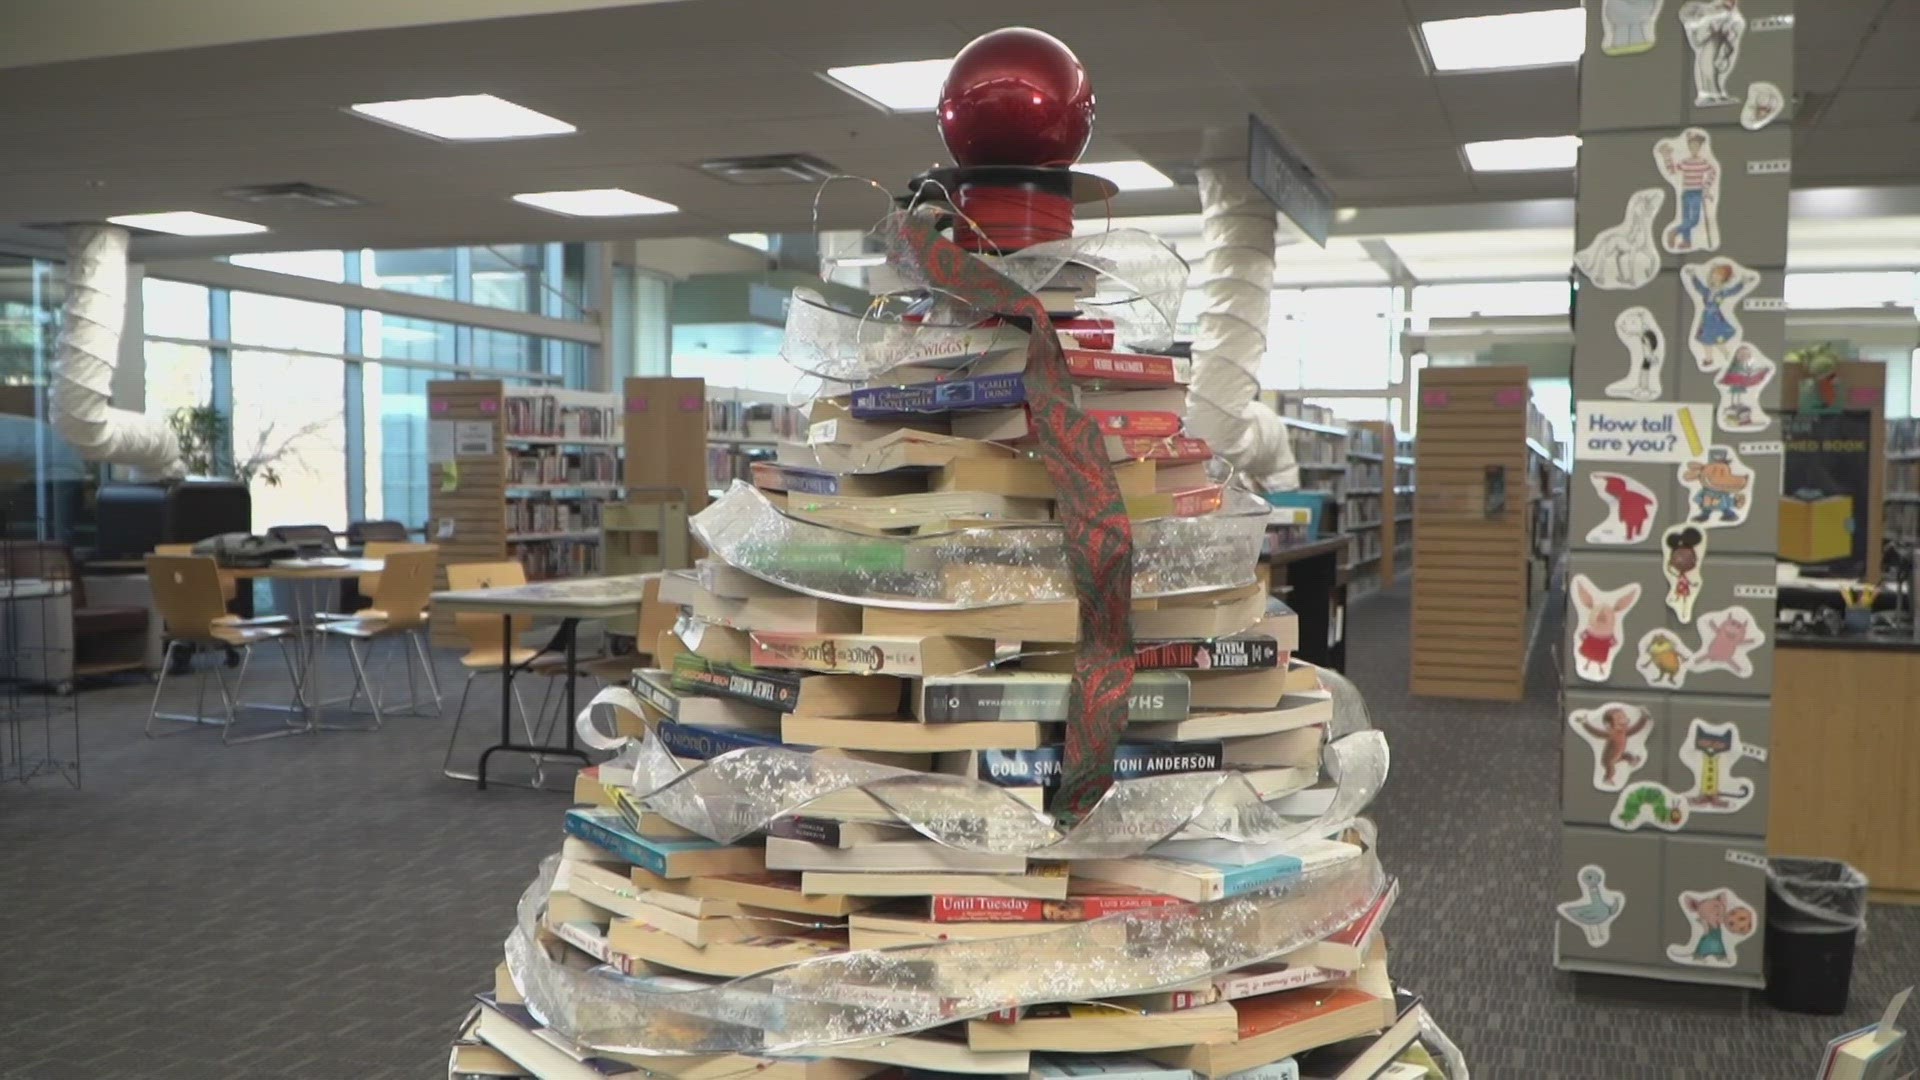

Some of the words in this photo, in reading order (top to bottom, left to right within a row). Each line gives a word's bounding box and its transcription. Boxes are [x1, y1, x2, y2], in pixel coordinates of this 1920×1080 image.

[924, 340, 963, 356] WIGGS
[1589, 414, 1636, 432] How
[1642, 414, 1672, 432] tall
[1588, 437, 1622, 450] are
[1626, 434, 1677, 456] you?
[800, 640, 837, 669] BLADE
[847, 646, 885, 671] CHALICE
[729, 675, 754, 695] CROWN
[753, 680, 775, 700] JEWEL
[672, 734, 711, 755] ORIGIN
[991, 762, 1028, 777] COLD
[1114, 758, 1142, 772] TONI
[1146, 755, 1215, 771] ANDERSON
[942, 897, 975, 910] Until
[979, 897, 1030, 913] Tuesday
[1119, 900, 1152, 908] CARLOS
